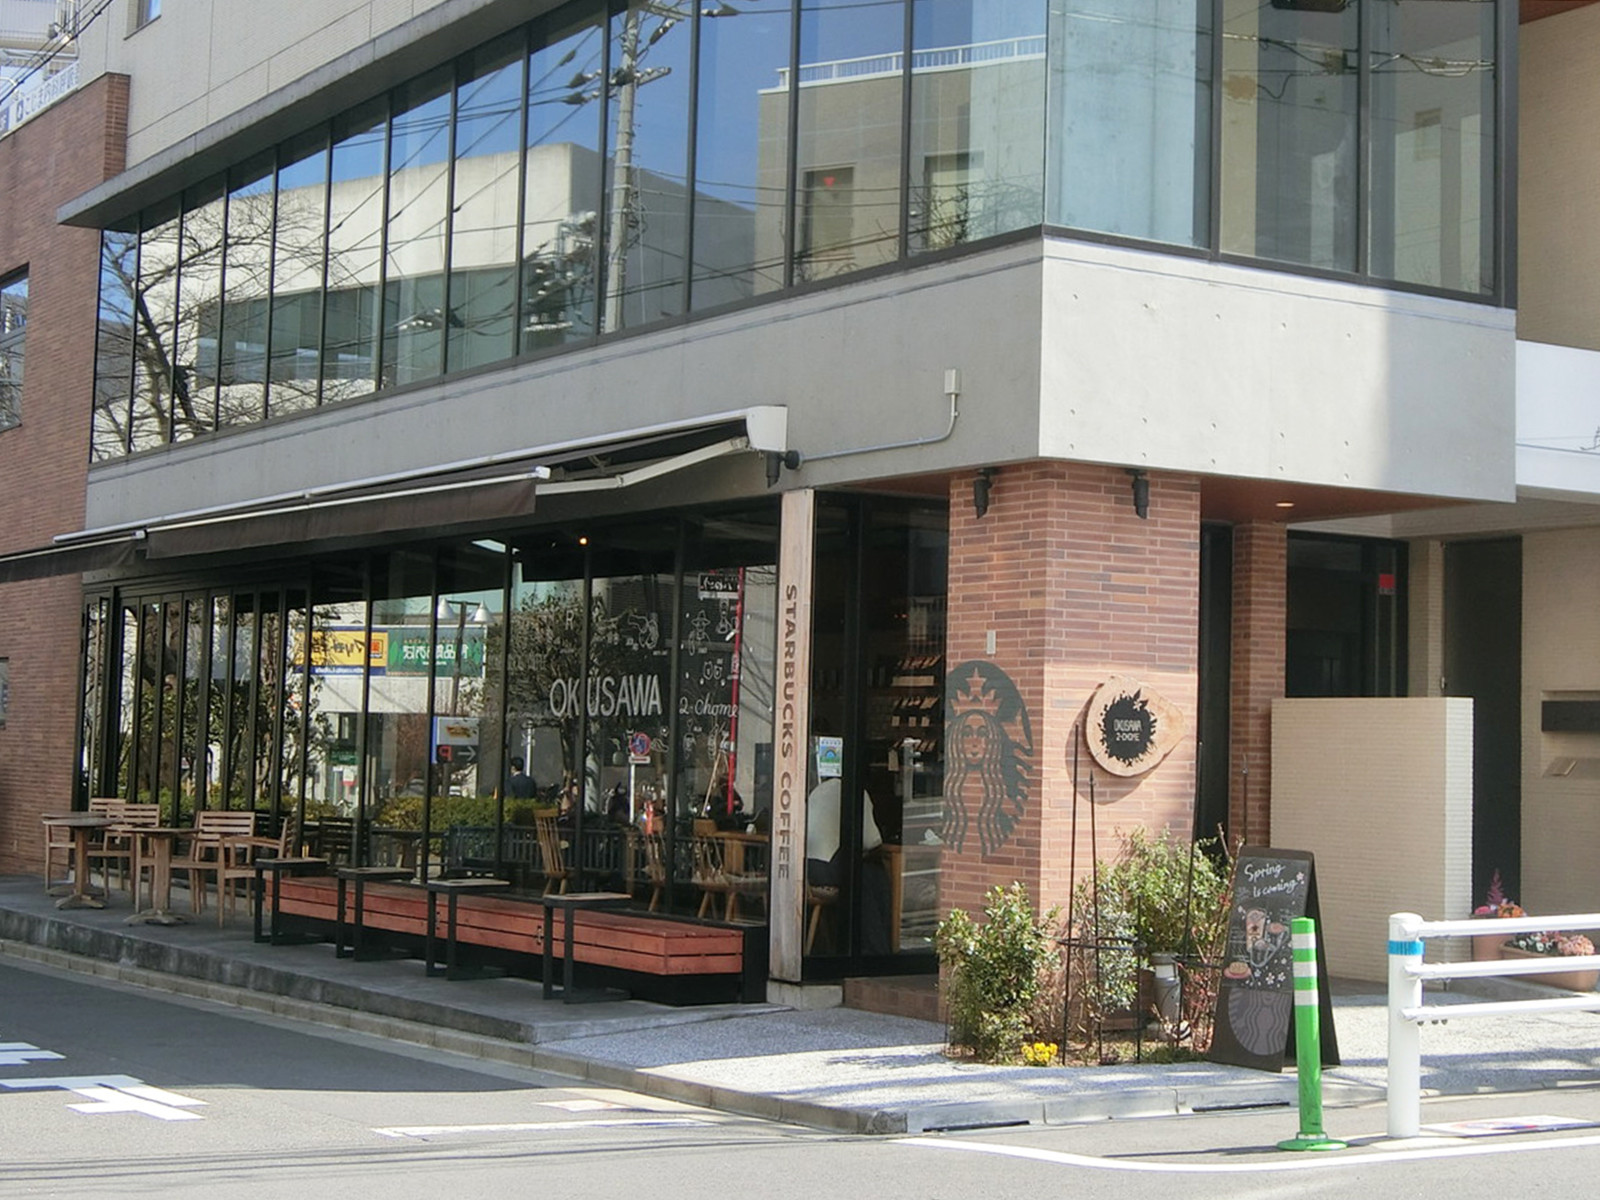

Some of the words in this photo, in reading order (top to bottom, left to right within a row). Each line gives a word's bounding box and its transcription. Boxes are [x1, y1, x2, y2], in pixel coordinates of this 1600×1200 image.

[781, 584, 798, 760] STARBUCKS
[549, 674, 662, 718] OKUSAWA
[777, 771, 793, 881] COFFEE
[1243, 862, 1287, 884] Spring
[1262, 878, 1299, 895] coming
